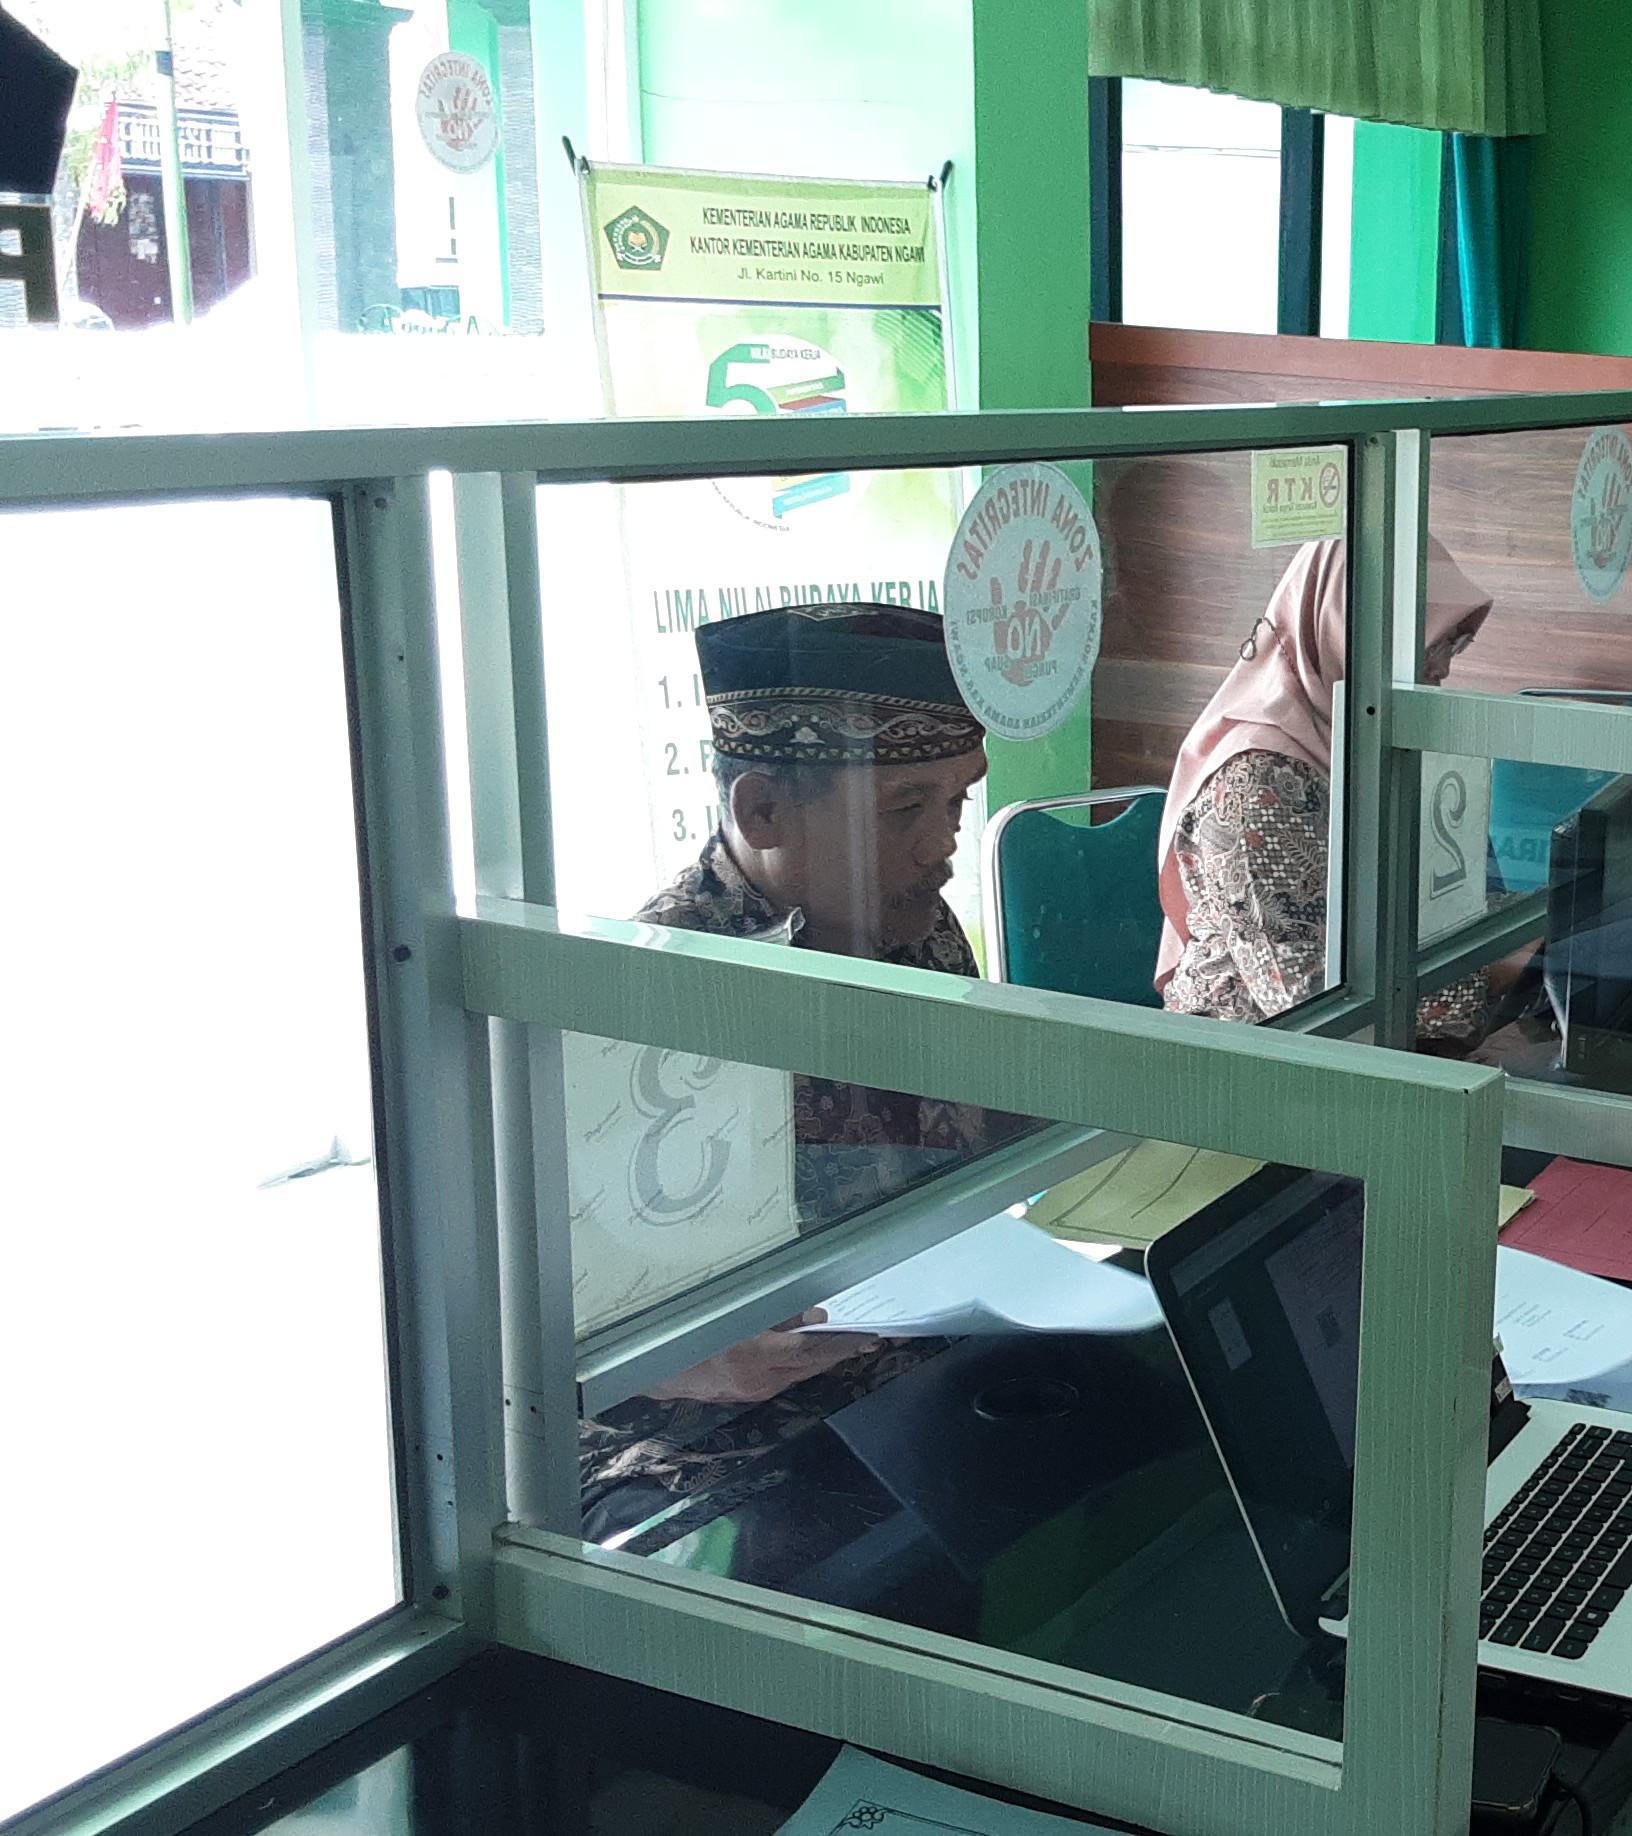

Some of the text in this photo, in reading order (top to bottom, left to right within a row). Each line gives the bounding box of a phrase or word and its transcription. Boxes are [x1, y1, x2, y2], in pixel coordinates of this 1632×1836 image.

[702, 206, 911, 235] KEMENTERIAN AGAMA REPUBLIK INDONESIA
[689, 235, 730, 255] KANTOR
[732, 238, 801, 258] KEMENTERIAN
[802, 242, 837, 260] AGAMA
[839, 243, 892, 263] KABUPATEN
[756, 267, 797, 283] Kartini
[800, 269, 823, 283] No.
[828, 270, 843, 284] 15
[847, 271, 884, 287] Ngawi
[653, 588, 710, 634] LIMA
[664, 742, 690, 776] 2.
[671, 808, 697, 843] 3.
